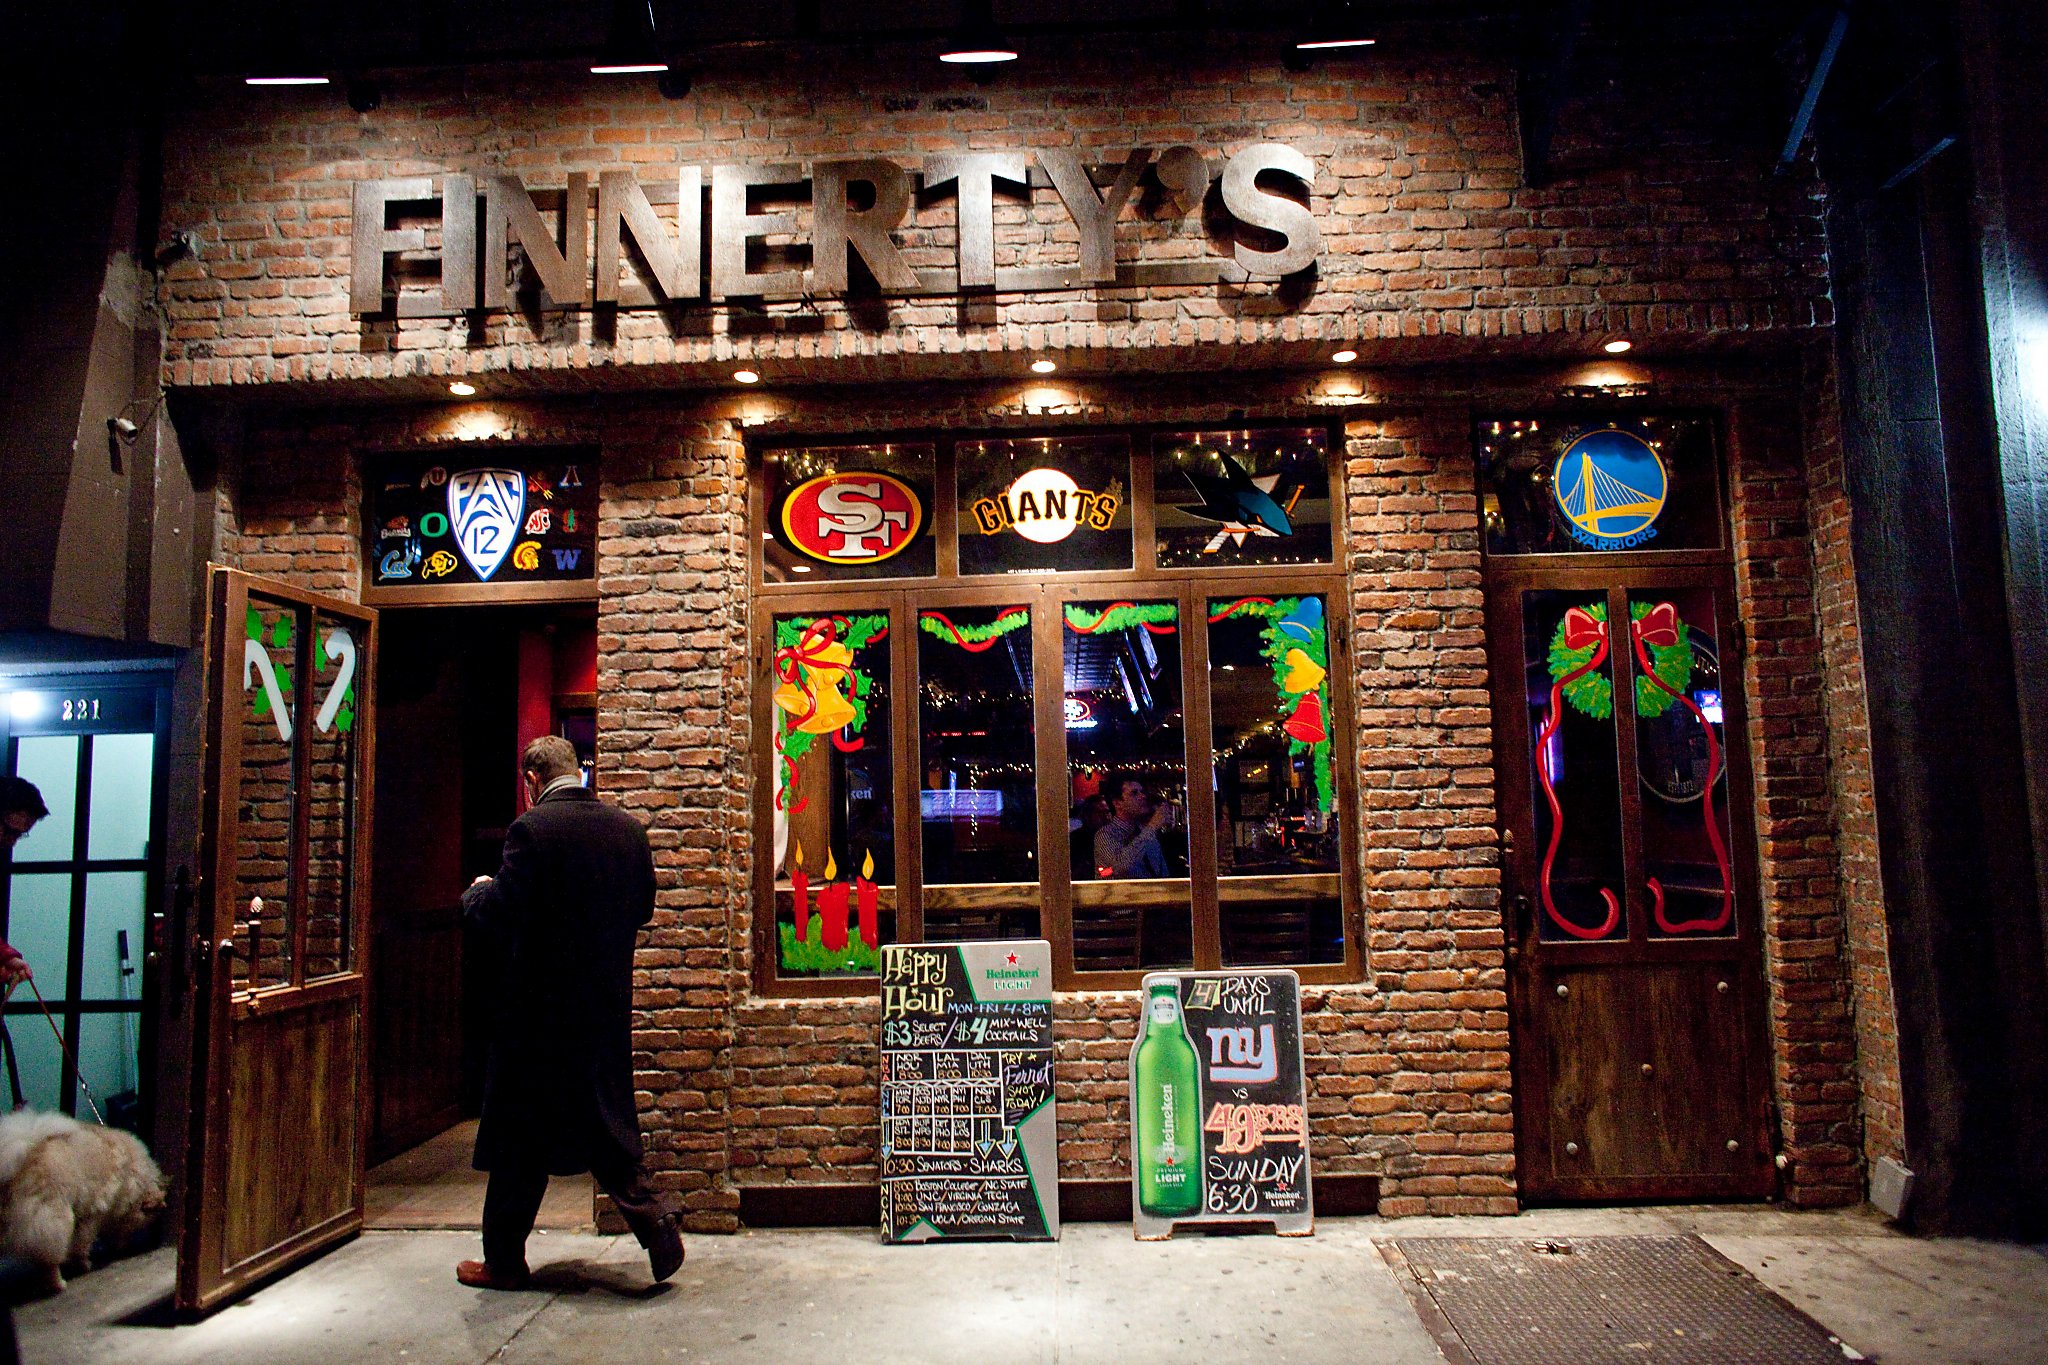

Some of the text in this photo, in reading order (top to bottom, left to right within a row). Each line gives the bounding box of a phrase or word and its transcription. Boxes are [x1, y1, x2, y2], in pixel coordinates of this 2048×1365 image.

[350, 142, 1321, 312] FINNERTY'S
[420, 512, 448, 537] O
[974, 489, 1120, 537] GIANTS
[474, 525, 500, 554] 12
[1571, 525, 1657, 551] WARRIORS
[552, 549, 581, 571] W
[62, 699, 101, 720] 221
[882, 948, 948, 986] Happy
[986, 968, 1039, 978] Heineken
[994, 980, 1032, 990] LIGHT
[1221, 975, 1271, 997] DAYS
[882, 986, 954, 1020] Hour
[1223, 992, 1276, 1016] UNTIL
[884, 1020, 912, 1046] $3
[954, 1017, 988, 1044] $4
[984, 1029, 1039, 1042] COCKTAILS
[1002, 1052, 1022, 1064] TRY
[1007, 1084, 1035, 1098] SHOT
[1161, 1083, 1175, 1155] Heineken
[883, 1159, 915, 1175] 10:30
[969, 1157, 1024, 1174] SHARKS
[1155, 1173, 1187, 1183] LIGHT
[1208, 1154, 1304, 1185] SUNDAY
[1207, 1182, 1258, 1214] 6:30
[1270, 1199, 1296, 1207] LIGHT
